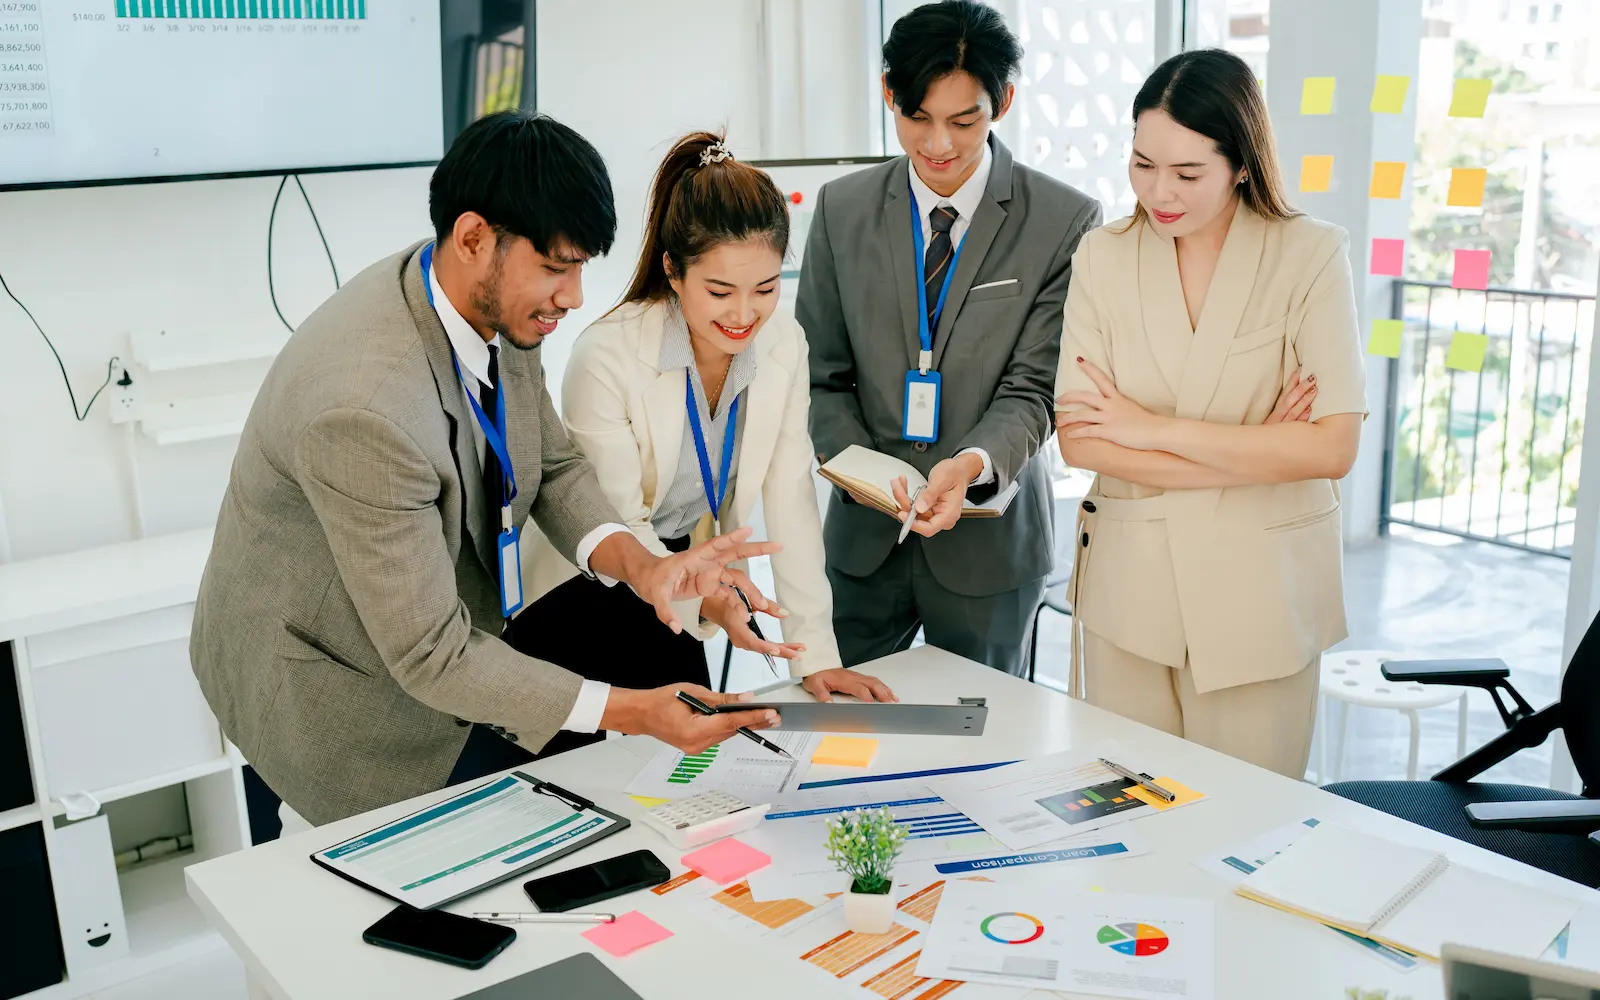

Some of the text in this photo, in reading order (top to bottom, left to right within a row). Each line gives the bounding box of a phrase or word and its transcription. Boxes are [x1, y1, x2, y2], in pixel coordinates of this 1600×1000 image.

[72, 12, 106, 22] $140.00
[0, 23, 39, 33] ,161,100
[971, 849, 1098, 869] Loan Comparison
